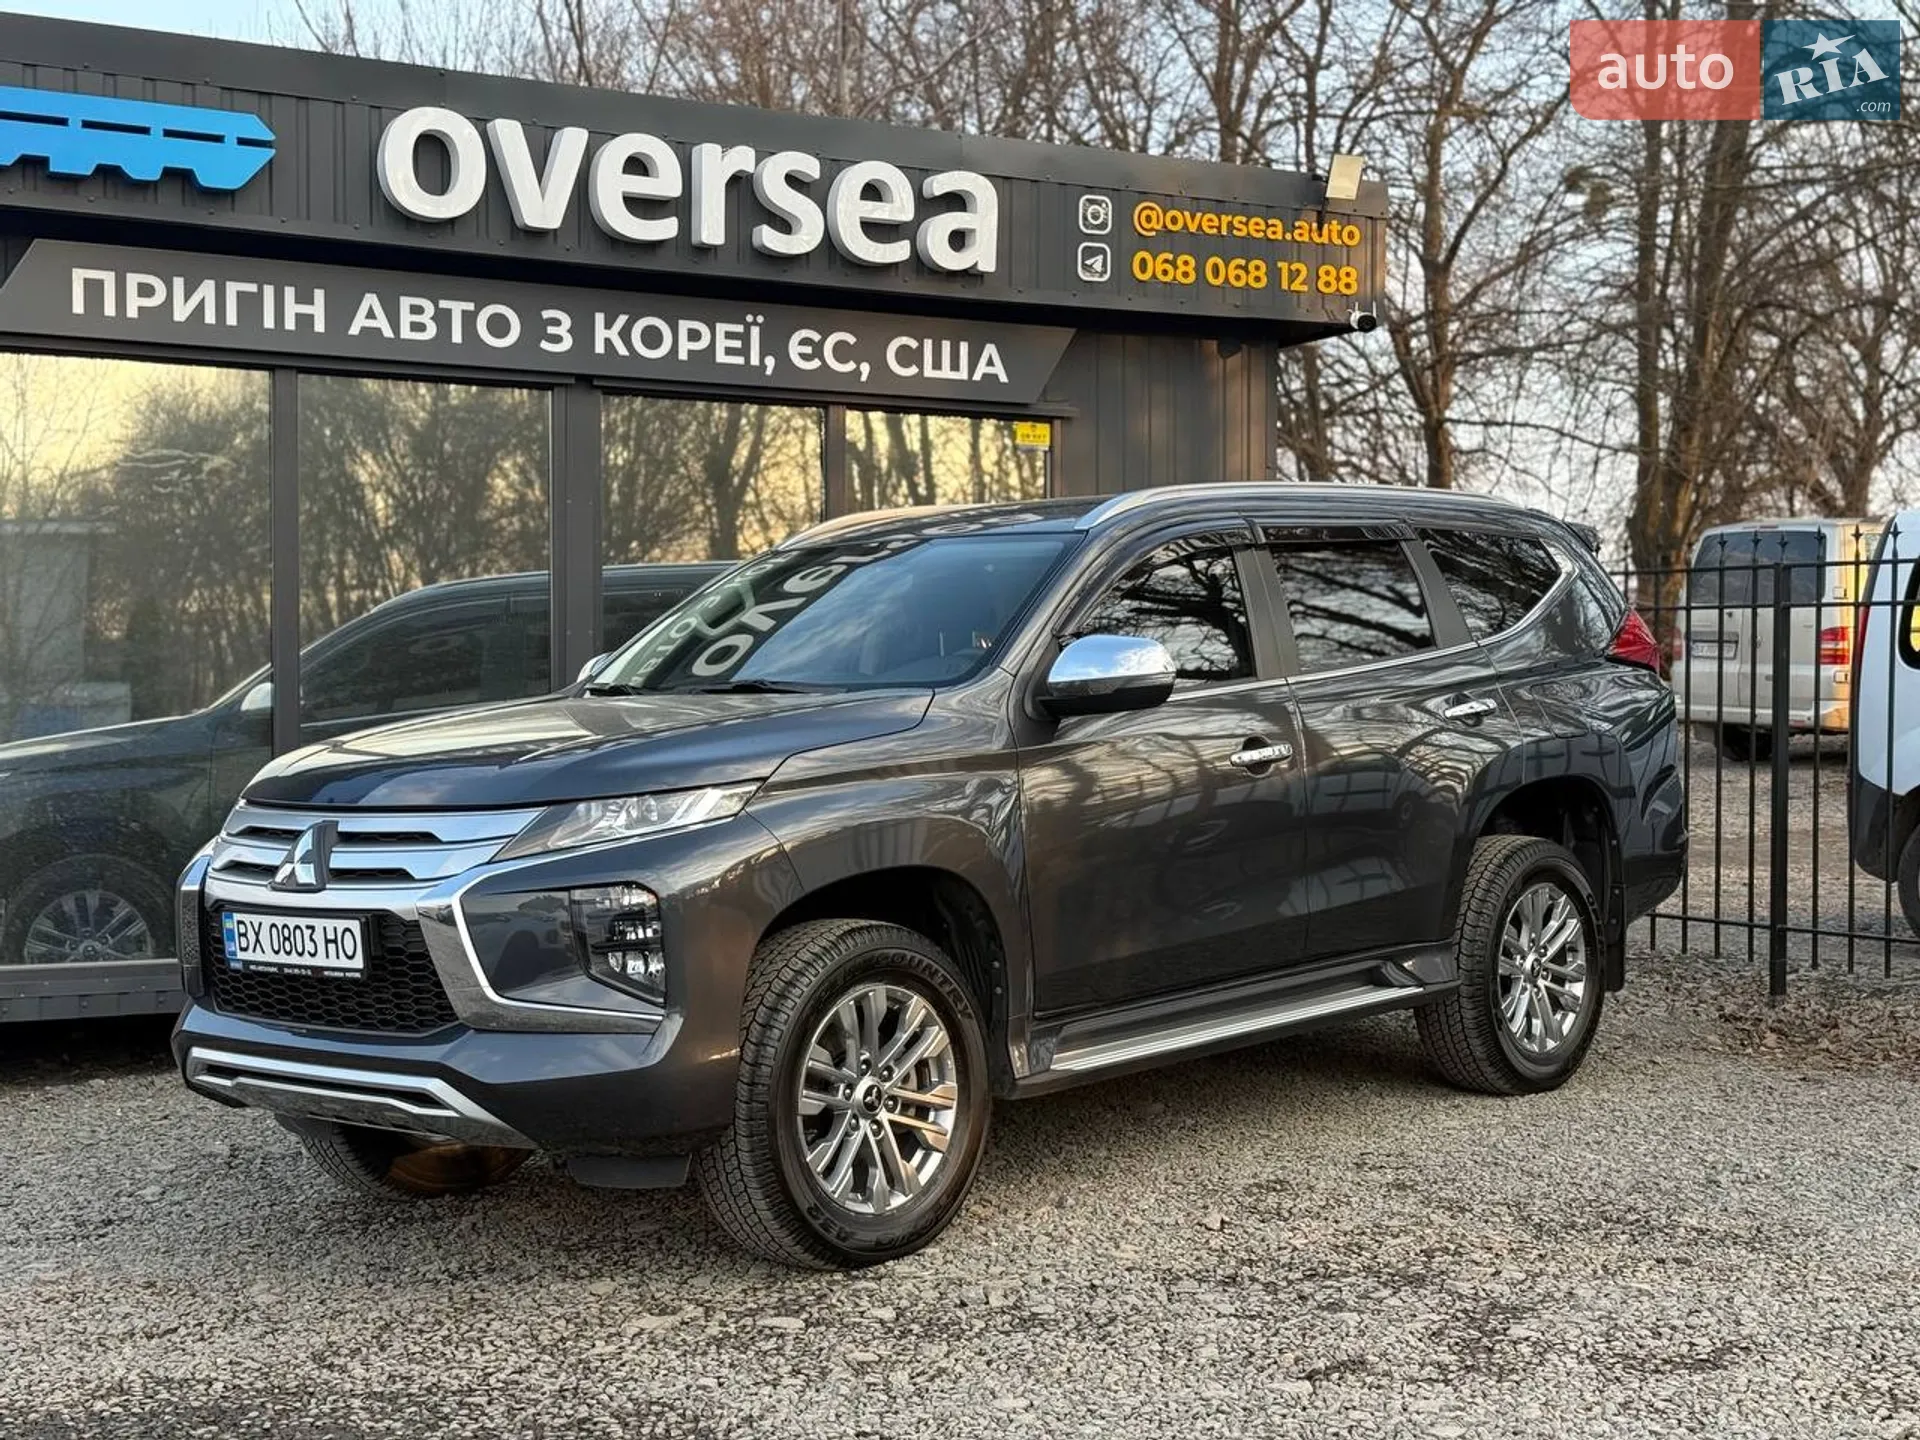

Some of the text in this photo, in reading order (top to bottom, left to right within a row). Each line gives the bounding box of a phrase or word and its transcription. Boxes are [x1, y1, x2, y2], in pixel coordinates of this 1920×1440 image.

[377, 106, 999, 274] oversea
[1133, 201, 1362, 248] @oversea.auto
[1132, 250, 1360, 296] 068 068 12 88
[71, 267, 326, 333] ПРИГІН
[348, 292, 522, 349] АВТО
[594, 312, 776, 376] КОРЕЇ,
[787, 328, 871, 383] ЄС,
[885, 335, 1010, 384] США
[236, 919, 357, 961] BX 0803 HO
